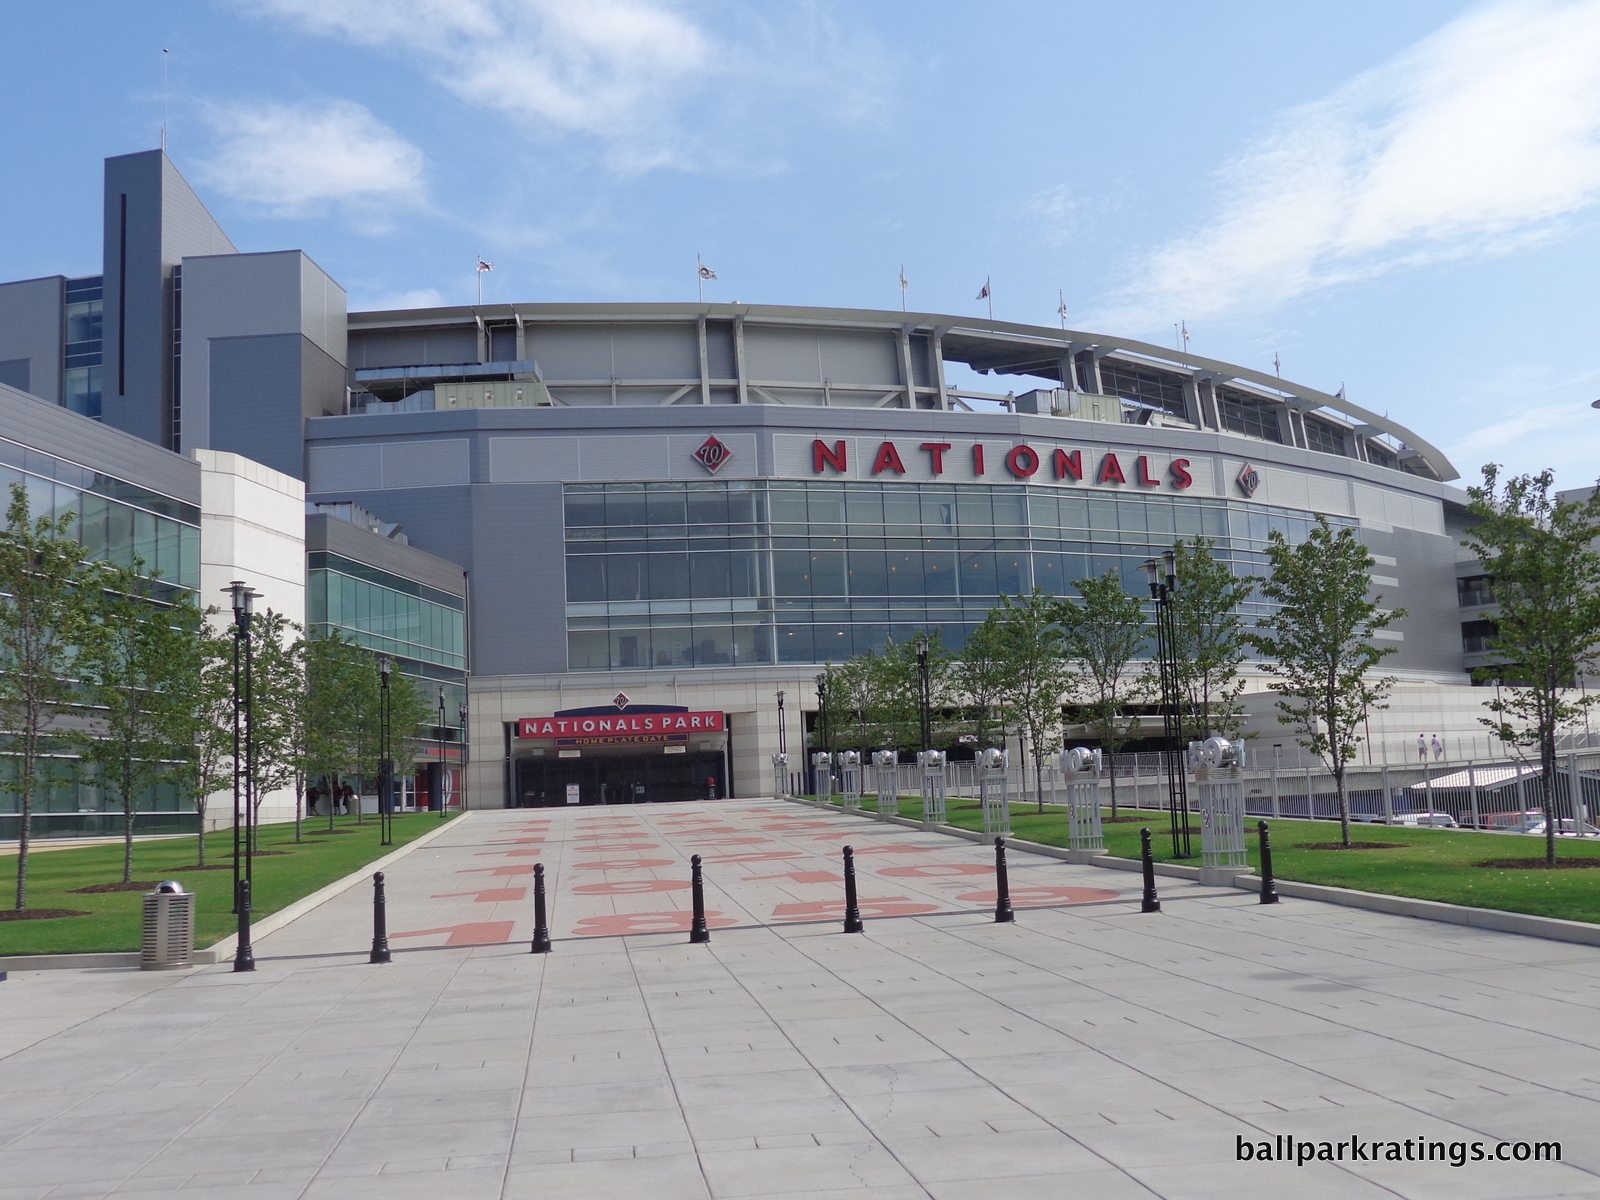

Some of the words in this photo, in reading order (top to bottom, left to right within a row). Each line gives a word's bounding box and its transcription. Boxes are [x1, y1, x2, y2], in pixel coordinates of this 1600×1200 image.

[812, 439, 1192, 489] NATIONALS
[525, 717, 654, 734] NATIONALS
[662, 716, 716, 729] PARK
[456, 845, 943, 875] 1924
[474, 831, 866, 857] 1937
[430, 864, 1000, 902] 1910
[389, 887, 1121, 943] 1859
